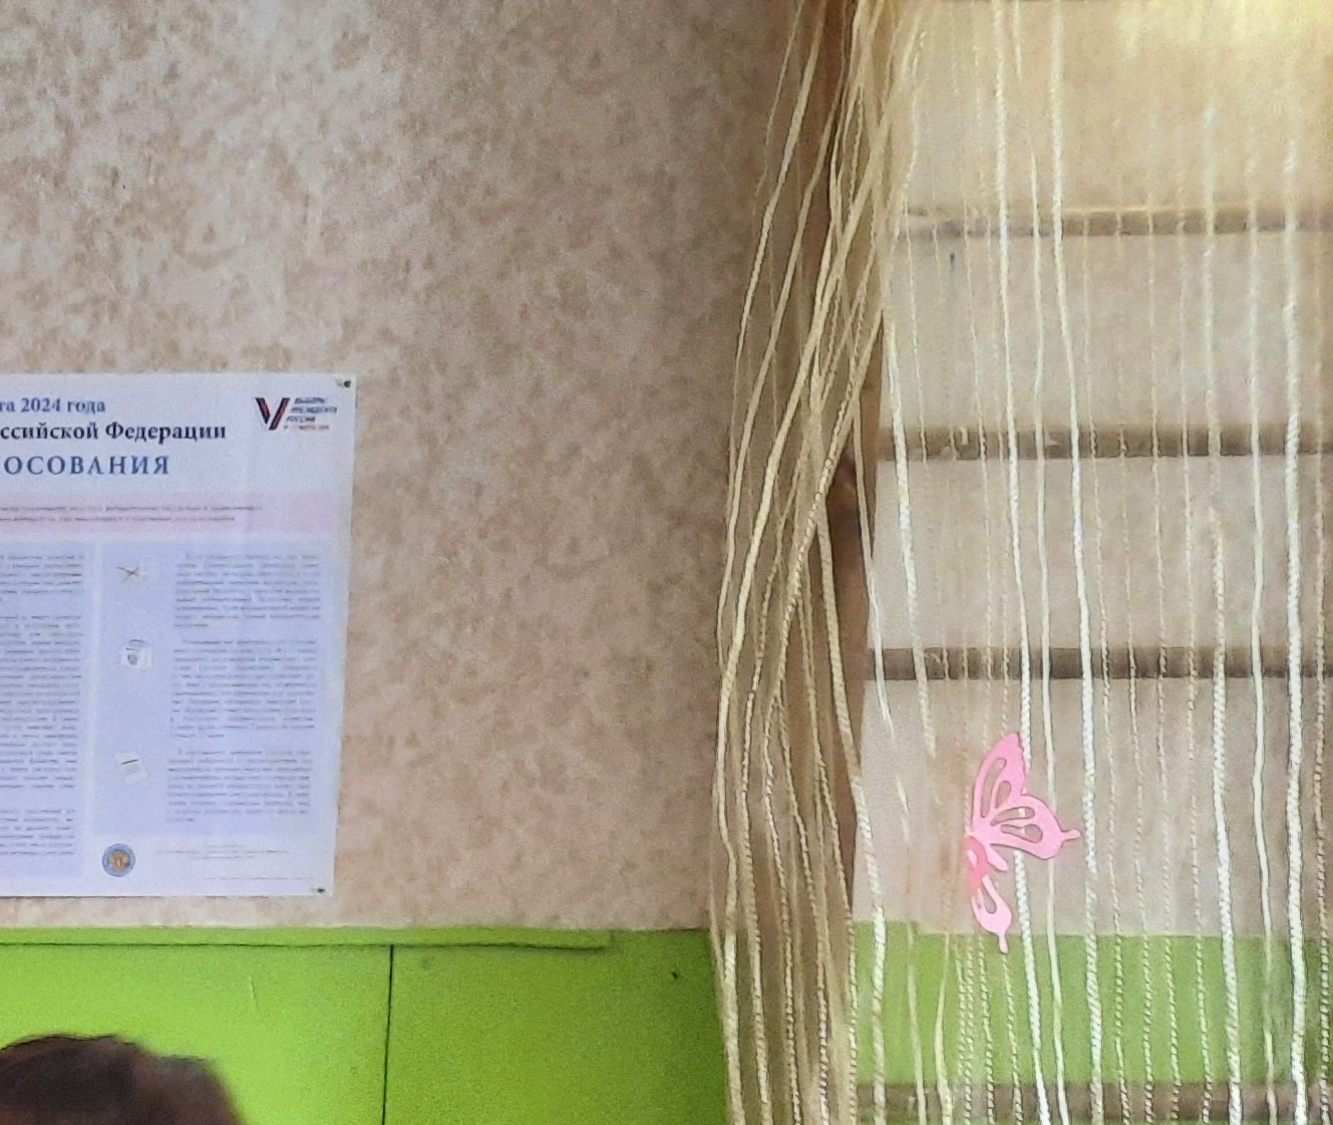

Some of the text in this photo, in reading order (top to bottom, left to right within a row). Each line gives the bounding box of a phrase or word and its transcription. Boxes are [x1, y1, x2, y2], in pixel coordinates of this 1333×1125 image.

[20, 397, 61, 413] 2024
[67, 401, 106, 415] года
[104, 421, 226, 445] Федерации
